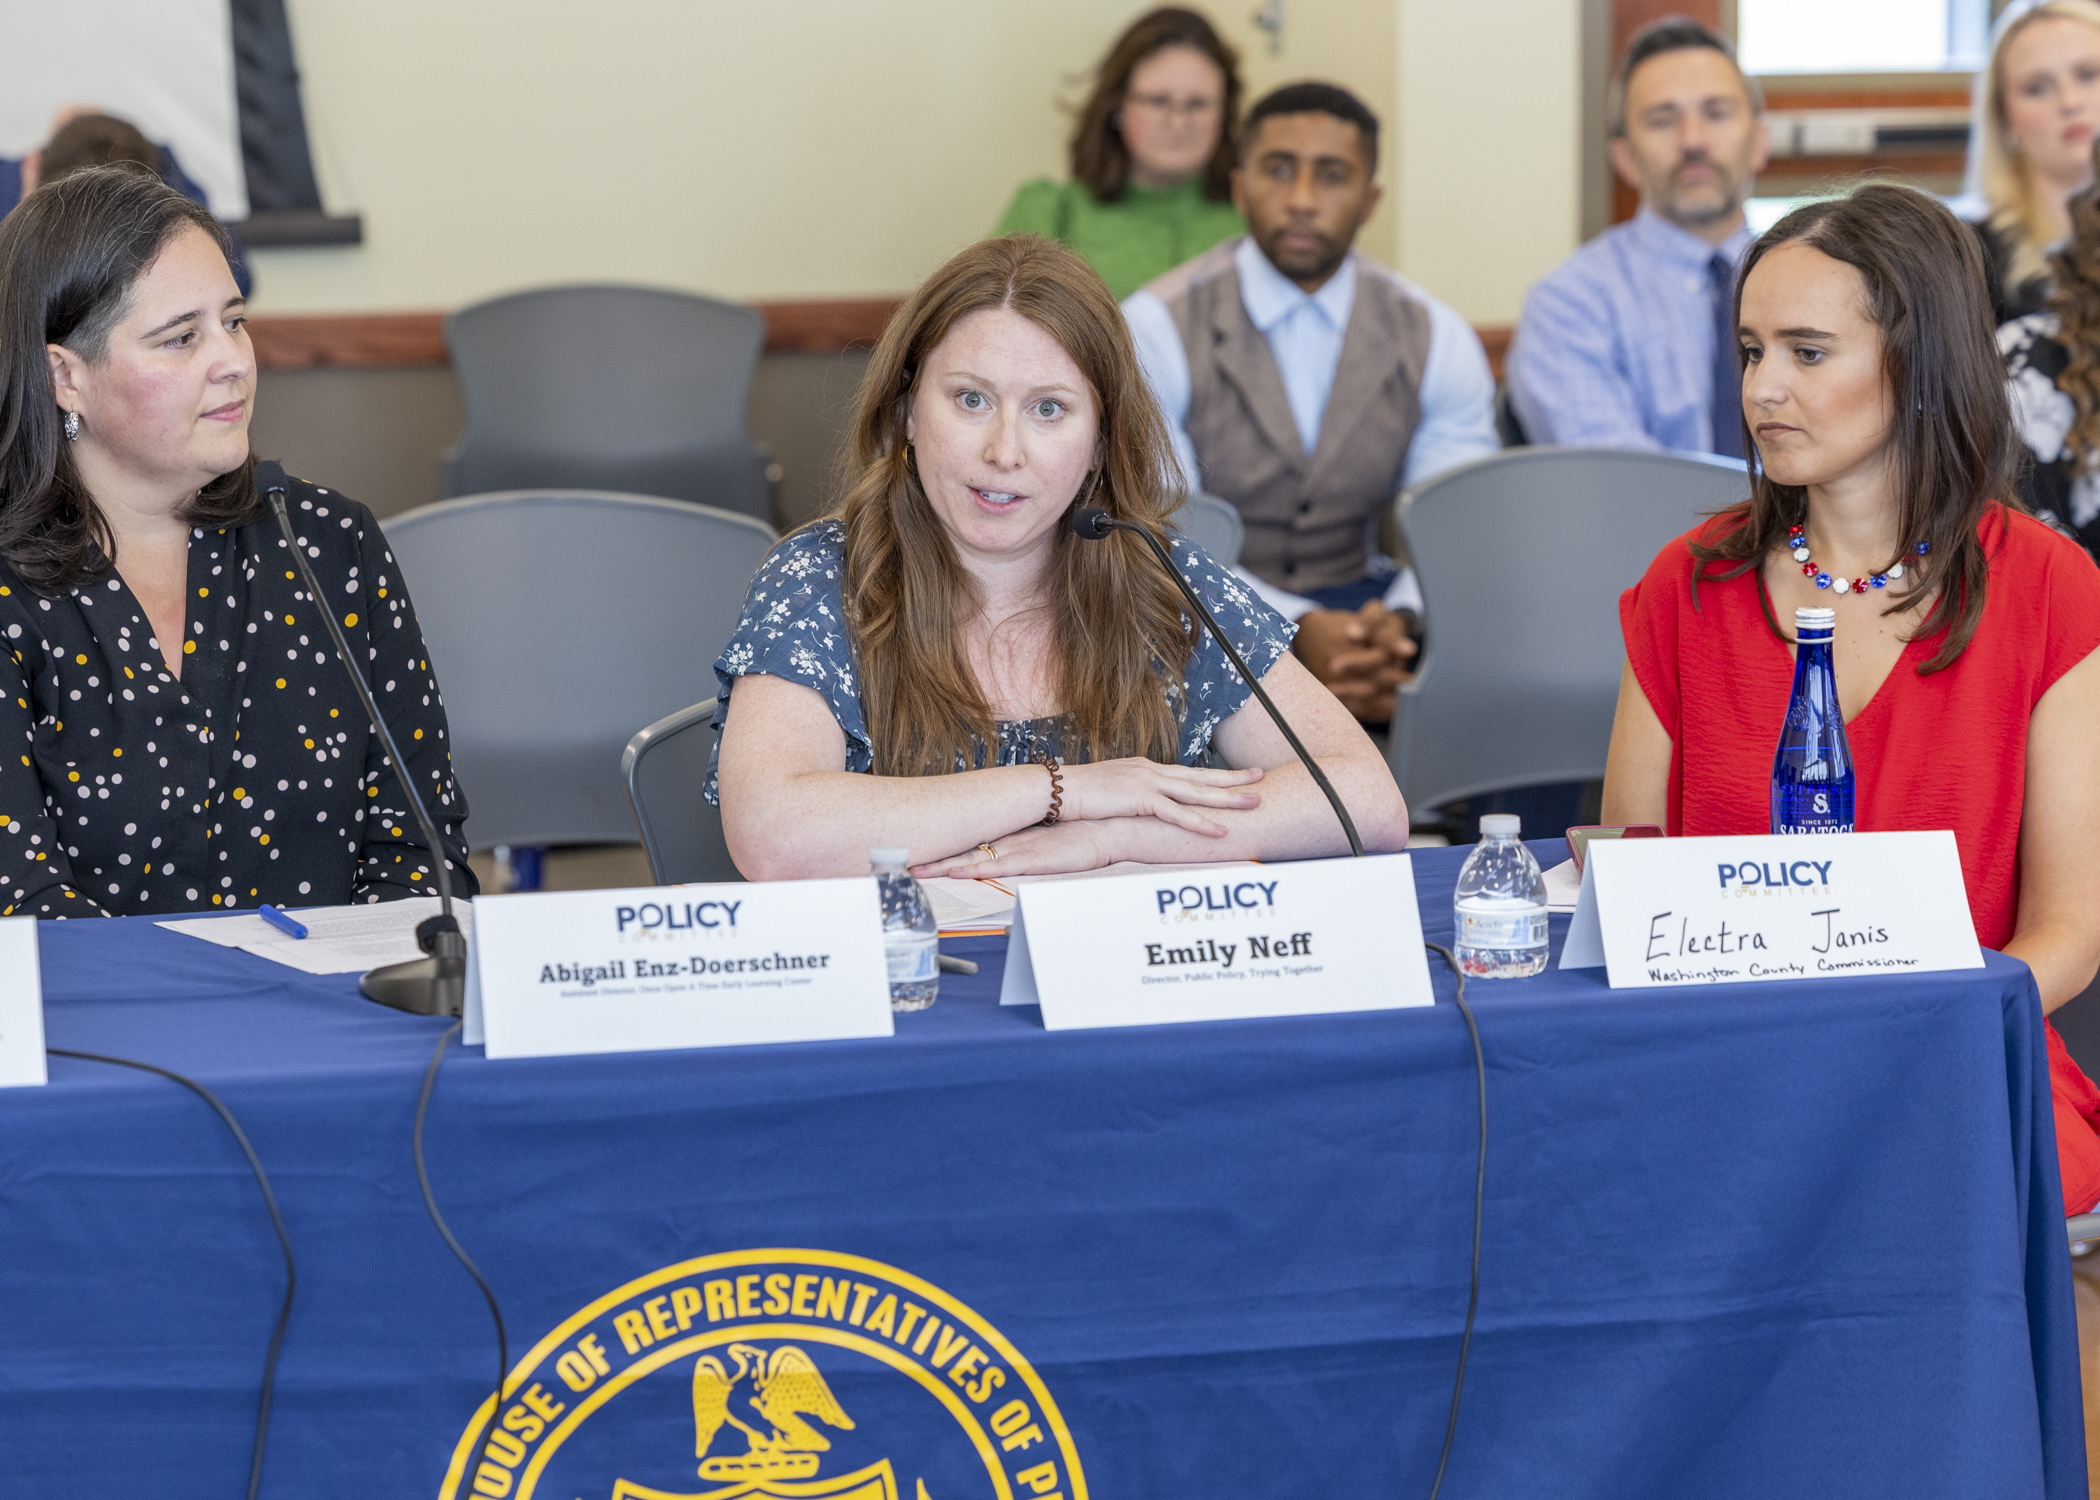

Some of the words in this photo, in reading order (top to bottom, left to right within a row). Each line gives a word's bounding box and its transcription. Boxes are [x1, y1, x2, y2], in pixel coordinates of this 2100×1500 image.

[1718, 860, 1833, 889] POLICY
[1156, 880, 1279, 914] POLICY
[1721, 886, 1832, 899] COMMITTEE
[616, 900, 742, 932] POLICY
[1159, 908, 1277, 925] COMMITTEE
[1144, 938, 1237, 968] Emily
[1248, 931, 1313, 959] Neff
[1646, 911, 1768, 962] Electra
[1811, 908, 1889, 953] Janis
[539, 959, 626, 987] Abigail
[634, 951, 831, 978] Enz-Doerschner
[1141, 975, 1182, 986] Director,
[1185, 972, 1213, 983] Public
[1216, 970, 1246, 981] Policy,
[1249, 968, 1281, 978] Trying
[1283, 964, 1324, 976] Together
[1647, 968, 1741, 983] Washington
[1750, 963, 1806, 978] County
[1817, 956, 1919, 971] Commissioner
[555, 1333, 612, 1395] OF
[612, 1273, 1007, 1404] REPRESENTATIVES
[990, 1399, 1044, 1453] OF
